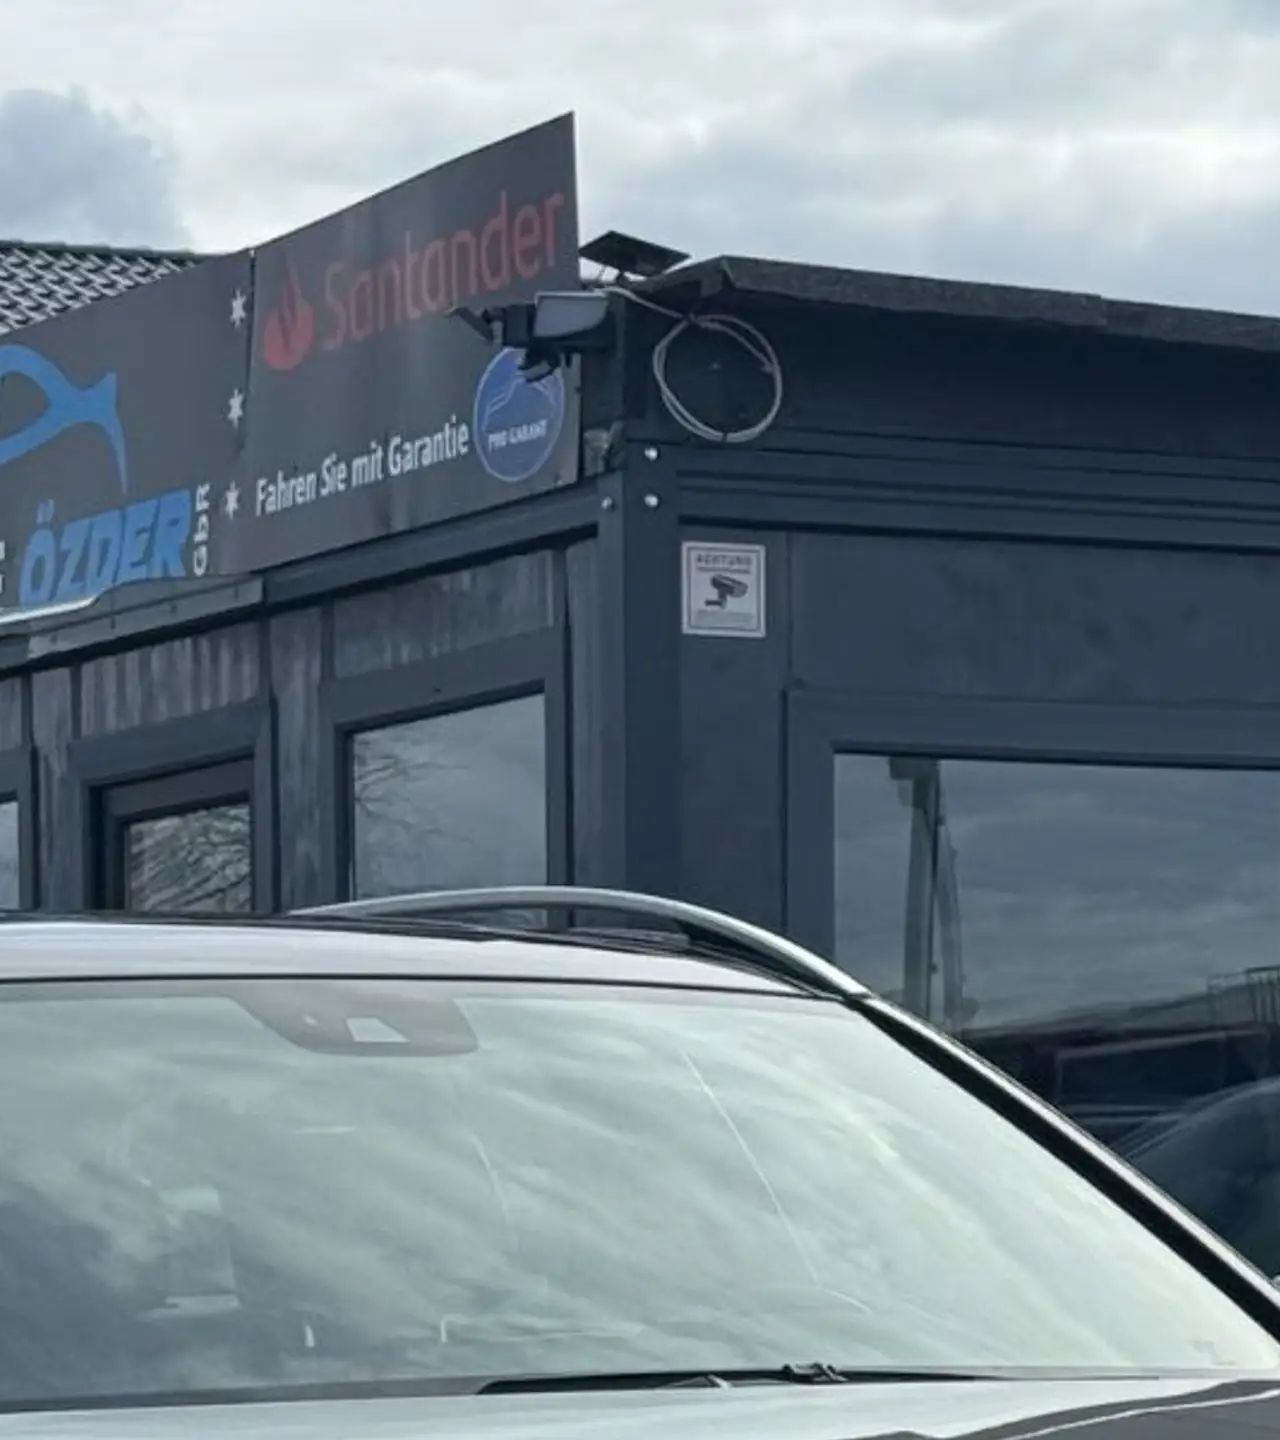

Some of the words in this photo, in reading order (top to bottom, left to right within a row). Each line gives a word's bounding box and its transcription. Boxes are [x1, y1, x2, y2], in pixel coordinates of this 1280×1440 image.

[323, 190, 565, 350] Santander
[255, 470, 318, 517] Fahren
[320, 451, 349, 498] Sie
[352, 439, 385, 486] mit
[387, 412, 470, 477] Garantie
[20, 489, 193, 607] ÖZDER
[193, 482, 212, 578] GbR
